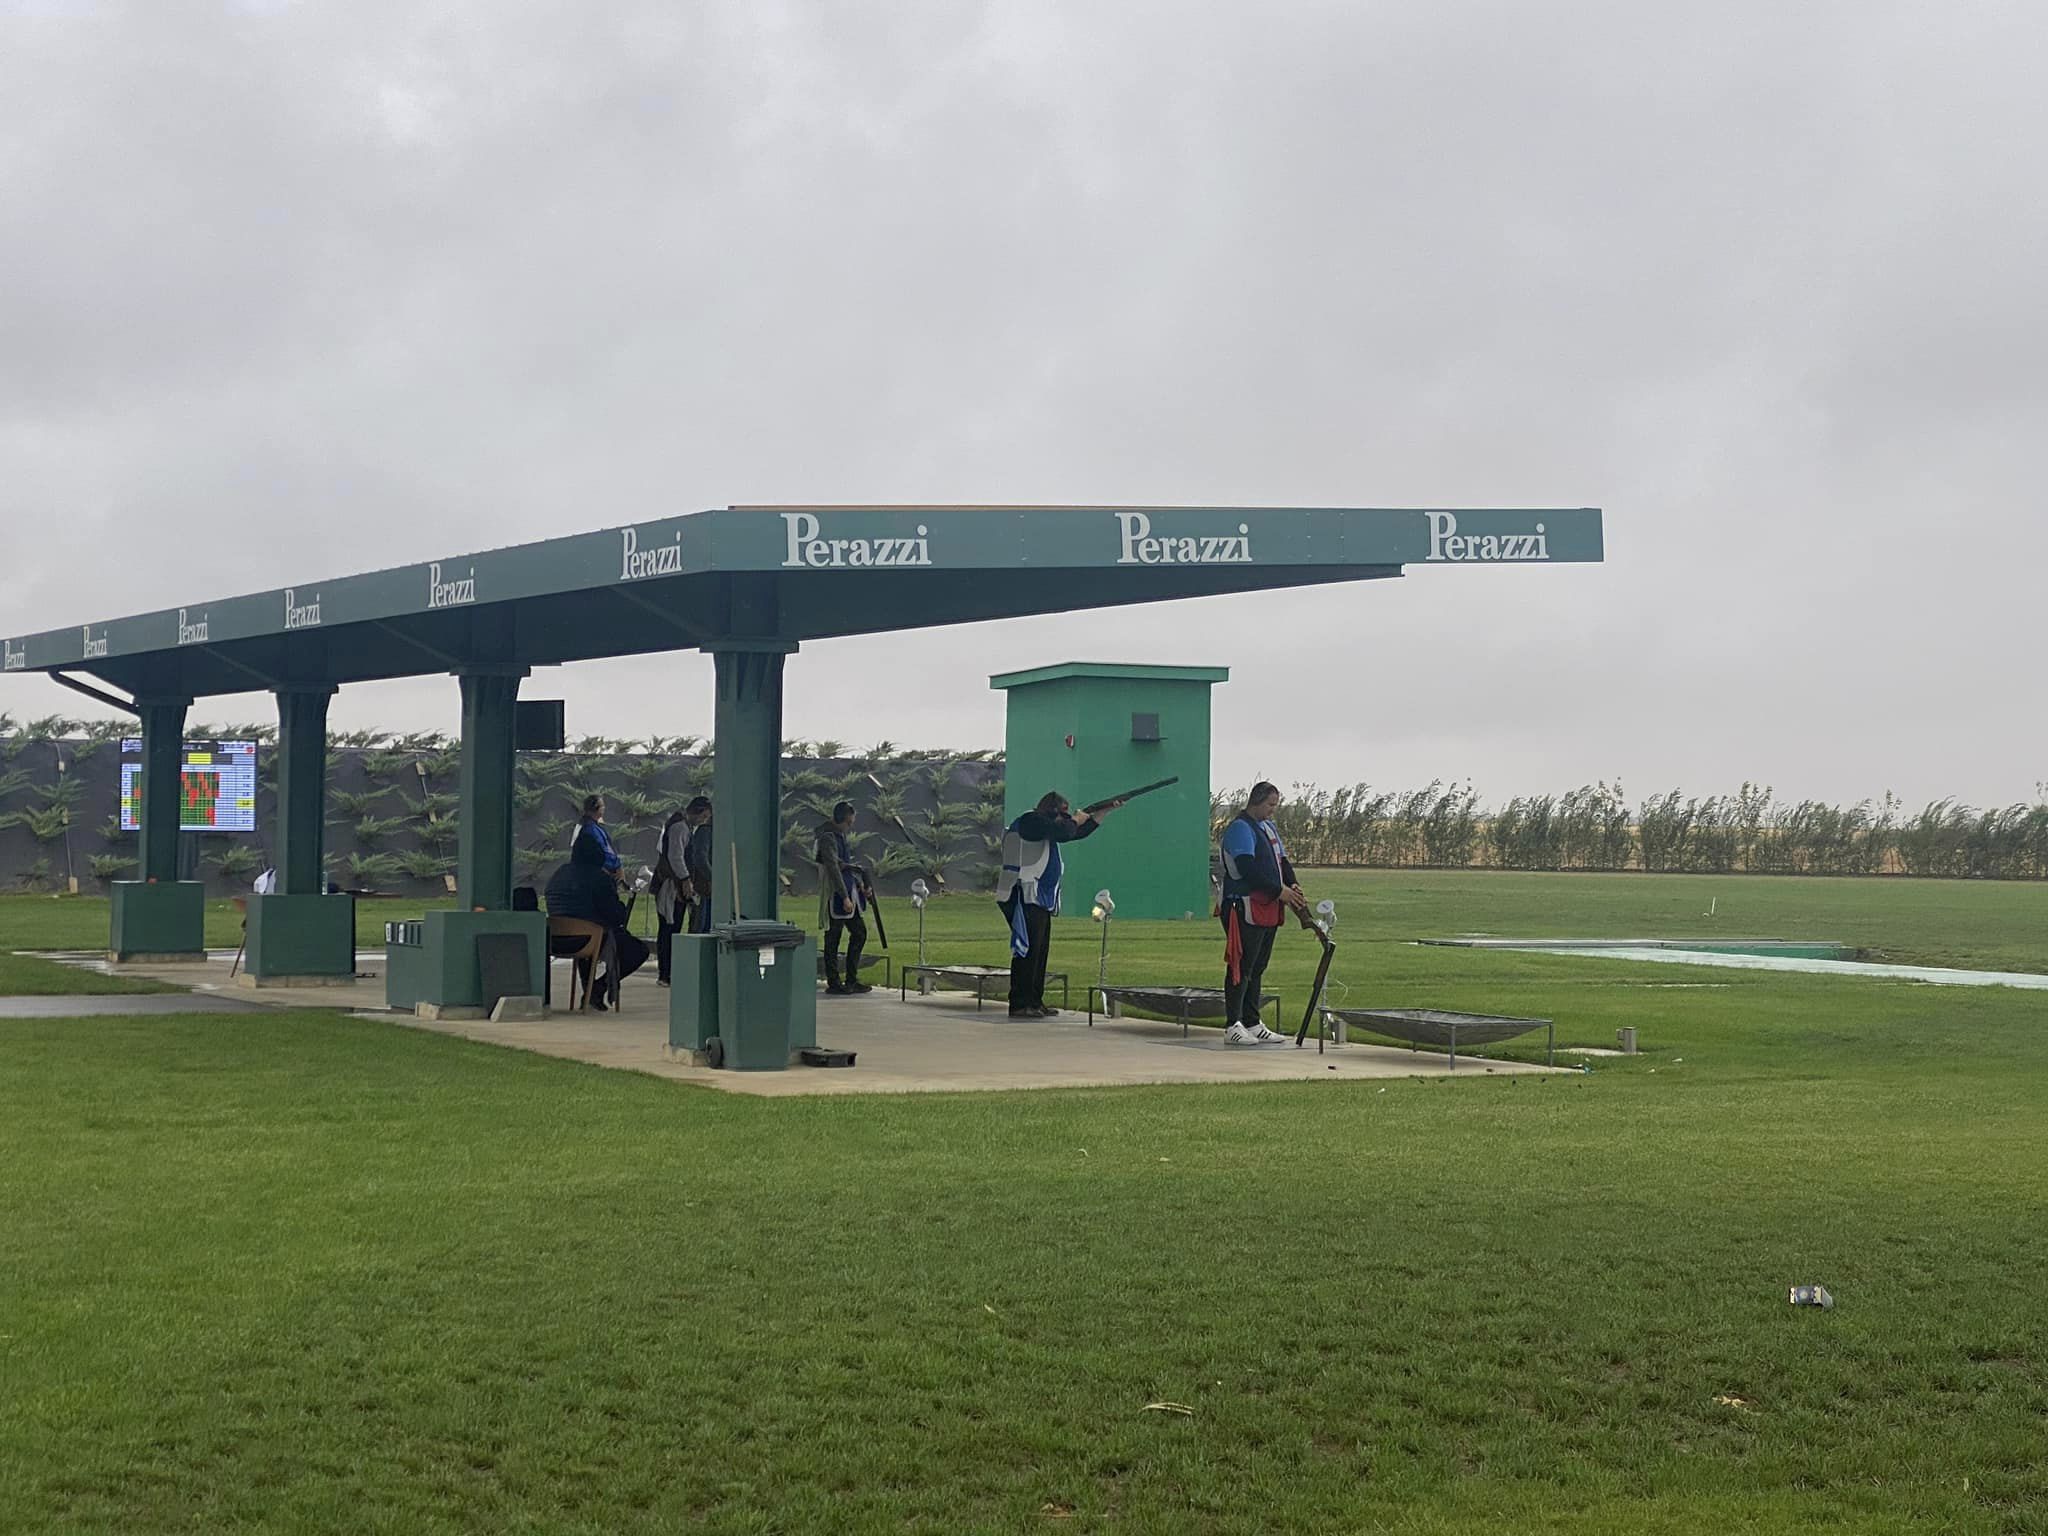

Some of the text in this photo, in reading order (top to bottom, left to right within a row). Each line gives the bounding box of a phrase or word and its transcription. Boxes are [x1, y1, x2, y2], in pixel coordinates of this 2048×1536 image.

[620, 528, 682, 580] Perazzi
[780, 512, 931, 566] Perazzi
[1115, 512, 1252, 563] Perazzi
[1425, 511, 1549, 561] Perazzi
[428, 564, 475, 608] Perazzi
[178, 609, 208, 644] Perazzi
[284, 589, 320, 629] Perazzi
[4, 641, 25, 670] Perazzi
[83, 626, 107, 658] Perazzi
